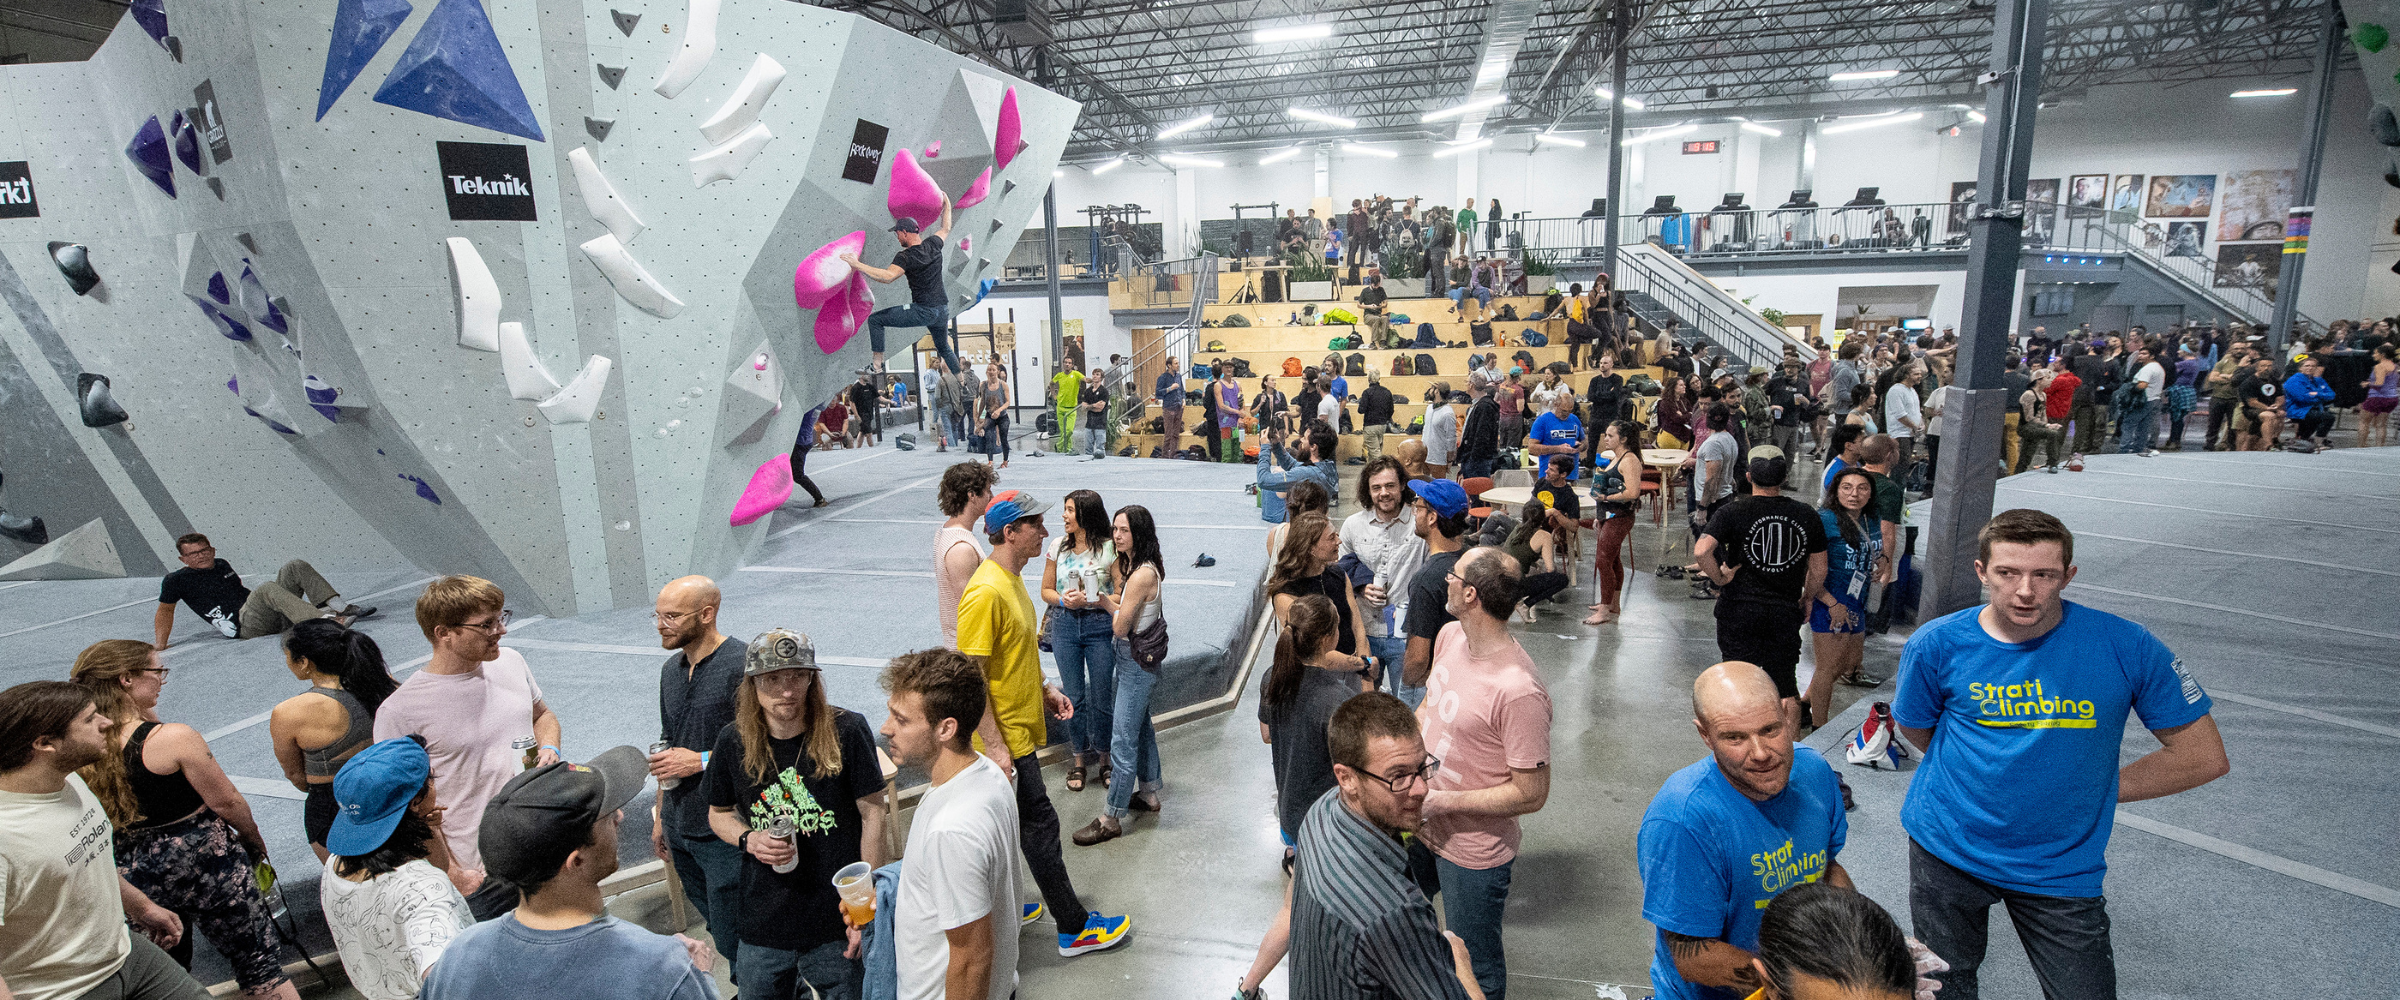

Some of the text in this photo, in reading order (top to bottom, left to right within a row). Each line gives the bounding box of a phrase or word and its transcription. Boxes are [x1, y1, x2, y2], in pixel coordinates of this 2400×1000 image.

[447, 172, 530, 196] Teknik
[1969, 678, 2042, 700] Strati
[1980, 696, 2095, 719] Climbing
[1750, 838, 1794, 876] Strat
